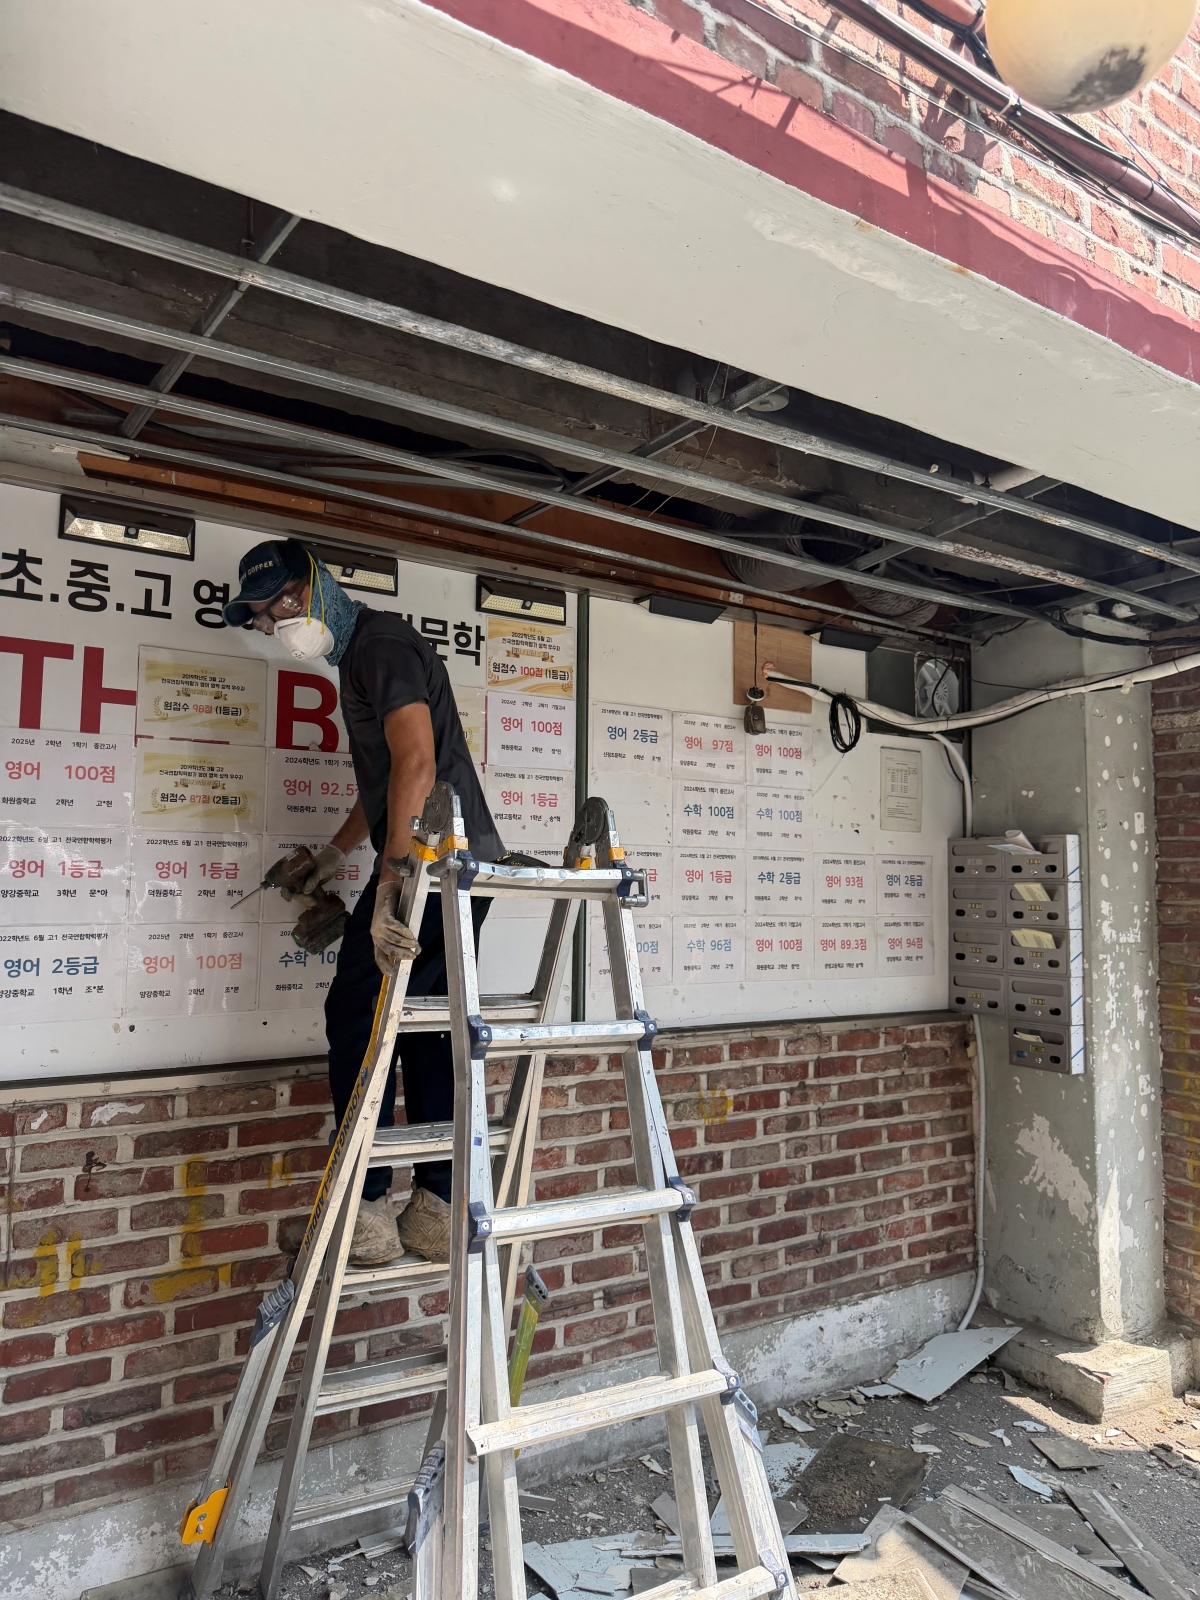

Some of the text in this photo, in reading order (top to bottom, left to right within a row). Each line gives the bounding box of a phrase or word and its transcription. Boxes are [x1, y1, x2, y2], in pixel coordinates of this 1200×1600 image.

[247, 560, 274, 576] COFFEE
[0, 548, 172, 620] 초.중.고
[492, 661, 570, 681] 원점수 100점 (1등급)
[163, 700, 242, 717] 원점수 98점 (1등급)
[501, 716, 562, 736] 영어 100점
[607, 726, 659, 744] 영어 2등급
[11, 738, 35, 746] 2025년
[72, 741, 88, 749] 1학기
[93, 742, 117, 750] 중간고사
[684, 736, 733, 753] 영어 97점
[755, 744, 802, 760] 영어 100점
[284, 756, 355, 768] 2024학년도 1학기 기말
[5, 760, 115, 783] 영어 100점
[283, 779, 359, 797] 영어 92.5
[1, 796, 36, 805] 화원중학교
[160, 792, 241, 806] 원점수 87점 (2등급)
[501, 790, 558, 807] 영어 1등급
[323, 806, 340, 815] 2학년
[529, 814, 542, 822] 1학년
[683, 803, 734, 819] 수학 100점
[756, 807, 802, 823] 수학 100점
[181, 839, 192, 847] 6월
[9, 859, 103, 879] 영어 1등급
[155, 860, 240, 880] 영어 1등급
[334, 864, 361, 881] 등급
[685, 869, 732, 884] 영어 1등급
[757, 871, 801, 885] 수학 2등급
[825, 875, 863, 888] 영어 93점
[886, 874, 923, 887] 영어 2등급
[56, 889, 77, 897] 3학년
[197, 889, 216, 898] 2학년
[223, 931, 244, 939] 중간고사
[636, 940, 659, 954] 00점
[686, 938, 732, 953] 수학 96점
[755, 938, 802, 952] 영어 100점
[820, 938, 867, 952] 영어 89.3점
[887, 937, 923, 950] 영어 94점
[142, 952, 242, 974] 영어 100점
[278, 950, 337, 967] 수학 10
[3, 956, 99, 978] 영어 2등급
[53, 986, 73, 995] 1학년
[188, 988, 205, 996] 2학년
[315, 981, 330, 989] 2학년
